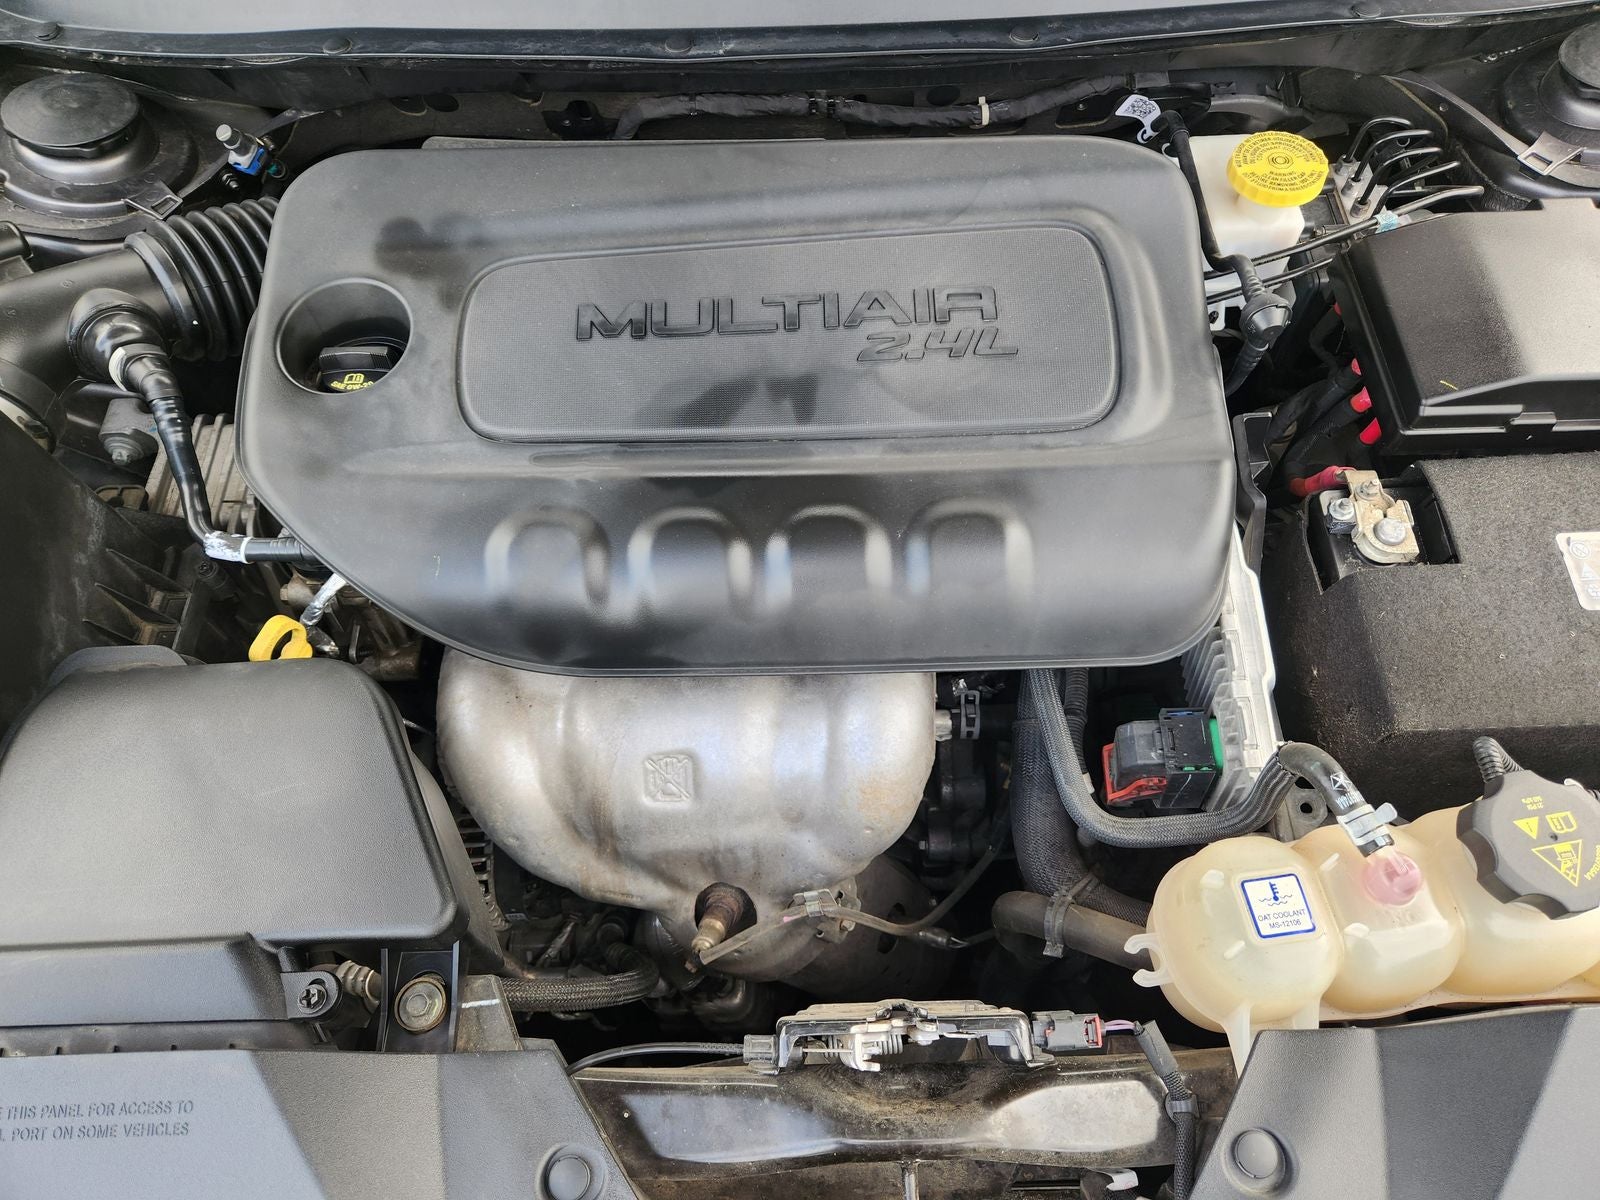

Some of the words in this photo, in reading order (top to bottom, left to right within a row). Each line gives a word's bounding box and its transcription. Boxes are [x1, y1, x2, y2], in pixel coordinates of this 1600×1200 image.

[576, 286, 998, 341] MULTIAIR
[857, 326, 1018, 362] 2.4L
[1258, 914, 1272, 922] OAT
[1272, 908, 1306, 920] COOLANT
[1269, 919, 1301, 929] MS-12106
[7, 1105, 36, 1120] THIS
[40, 1104, 84, 1119] PANEL
[88, 1102, 115, 1117] FOR
[118, 1101, 172, 1116] ACCESS
[177, 1100, 194, 1114] TO
[11, 1126, 47, 1142] PORT
[52, 1126, 74, 1139] ON
[77, 1124, 117, 1139] SOME
[123, 1122, 189, 1138] VEHICLES
